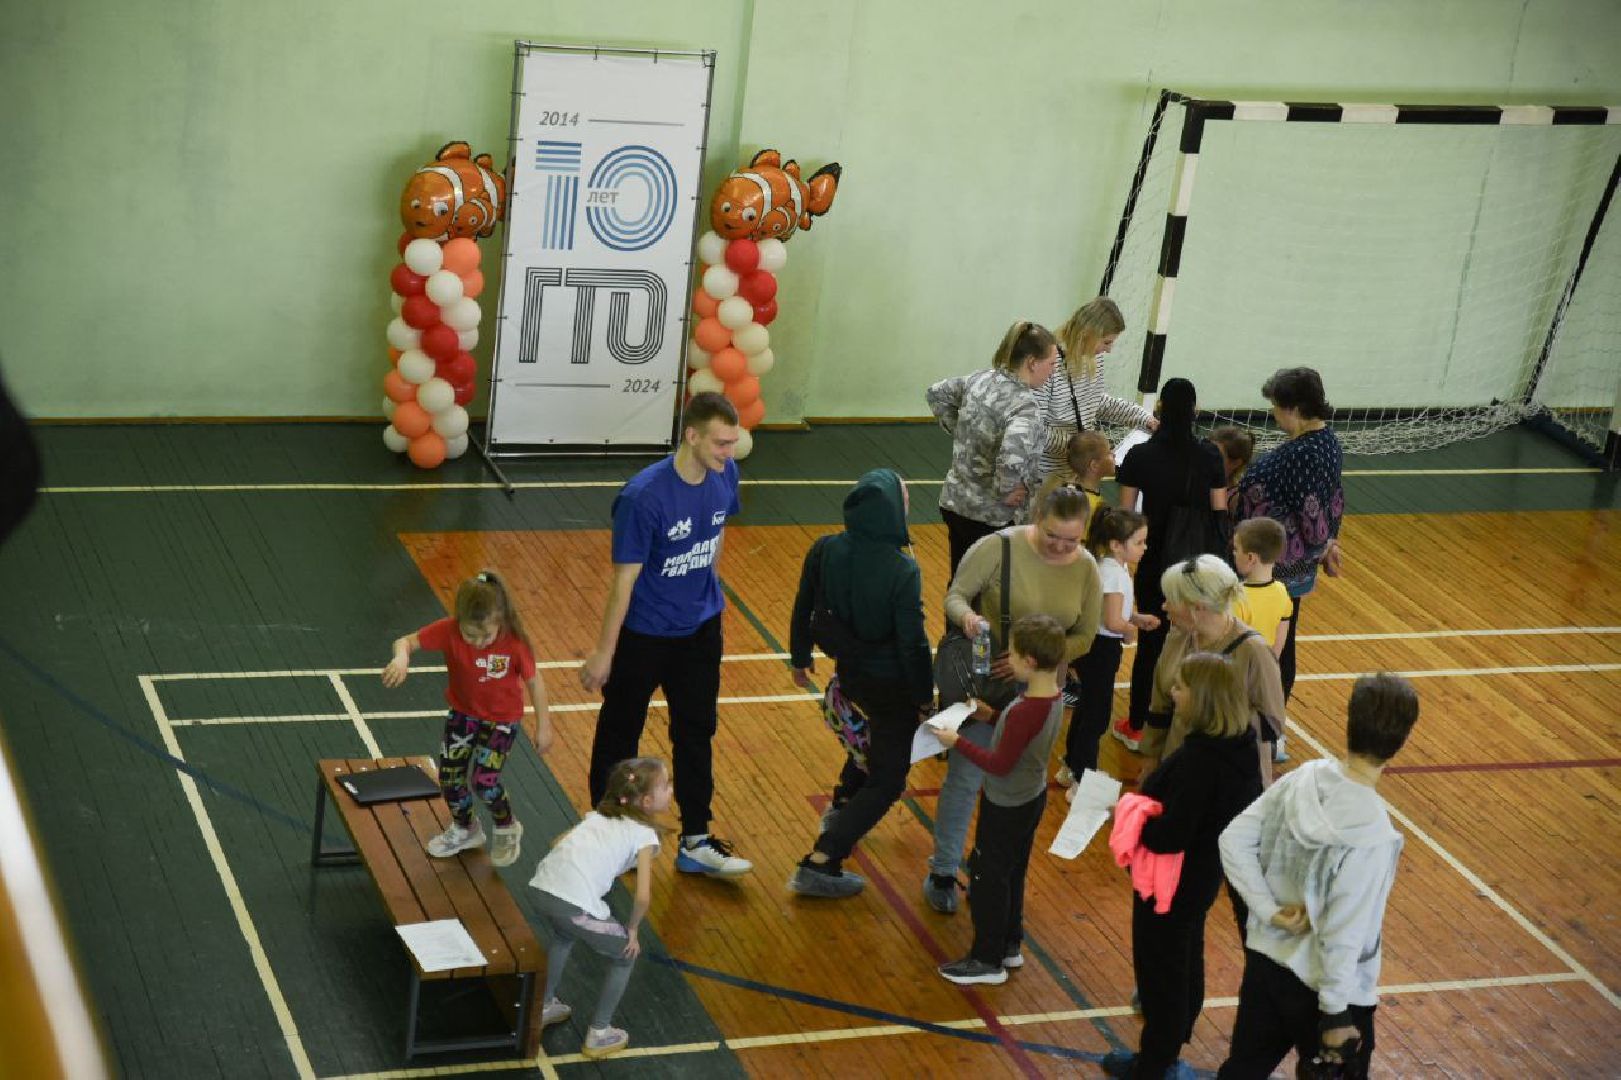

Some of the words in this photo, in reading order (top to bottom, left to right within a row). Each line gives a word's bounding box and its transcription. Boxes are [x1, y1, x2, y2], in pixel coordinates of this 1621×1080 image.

[539, 111, 580, 126] 2014
[535, 140, 678, 251] 10
[586, 188, 620, 203] лет
[519, 267, 668, 364] ГТО
[623, 378, 661, 393] 2024
